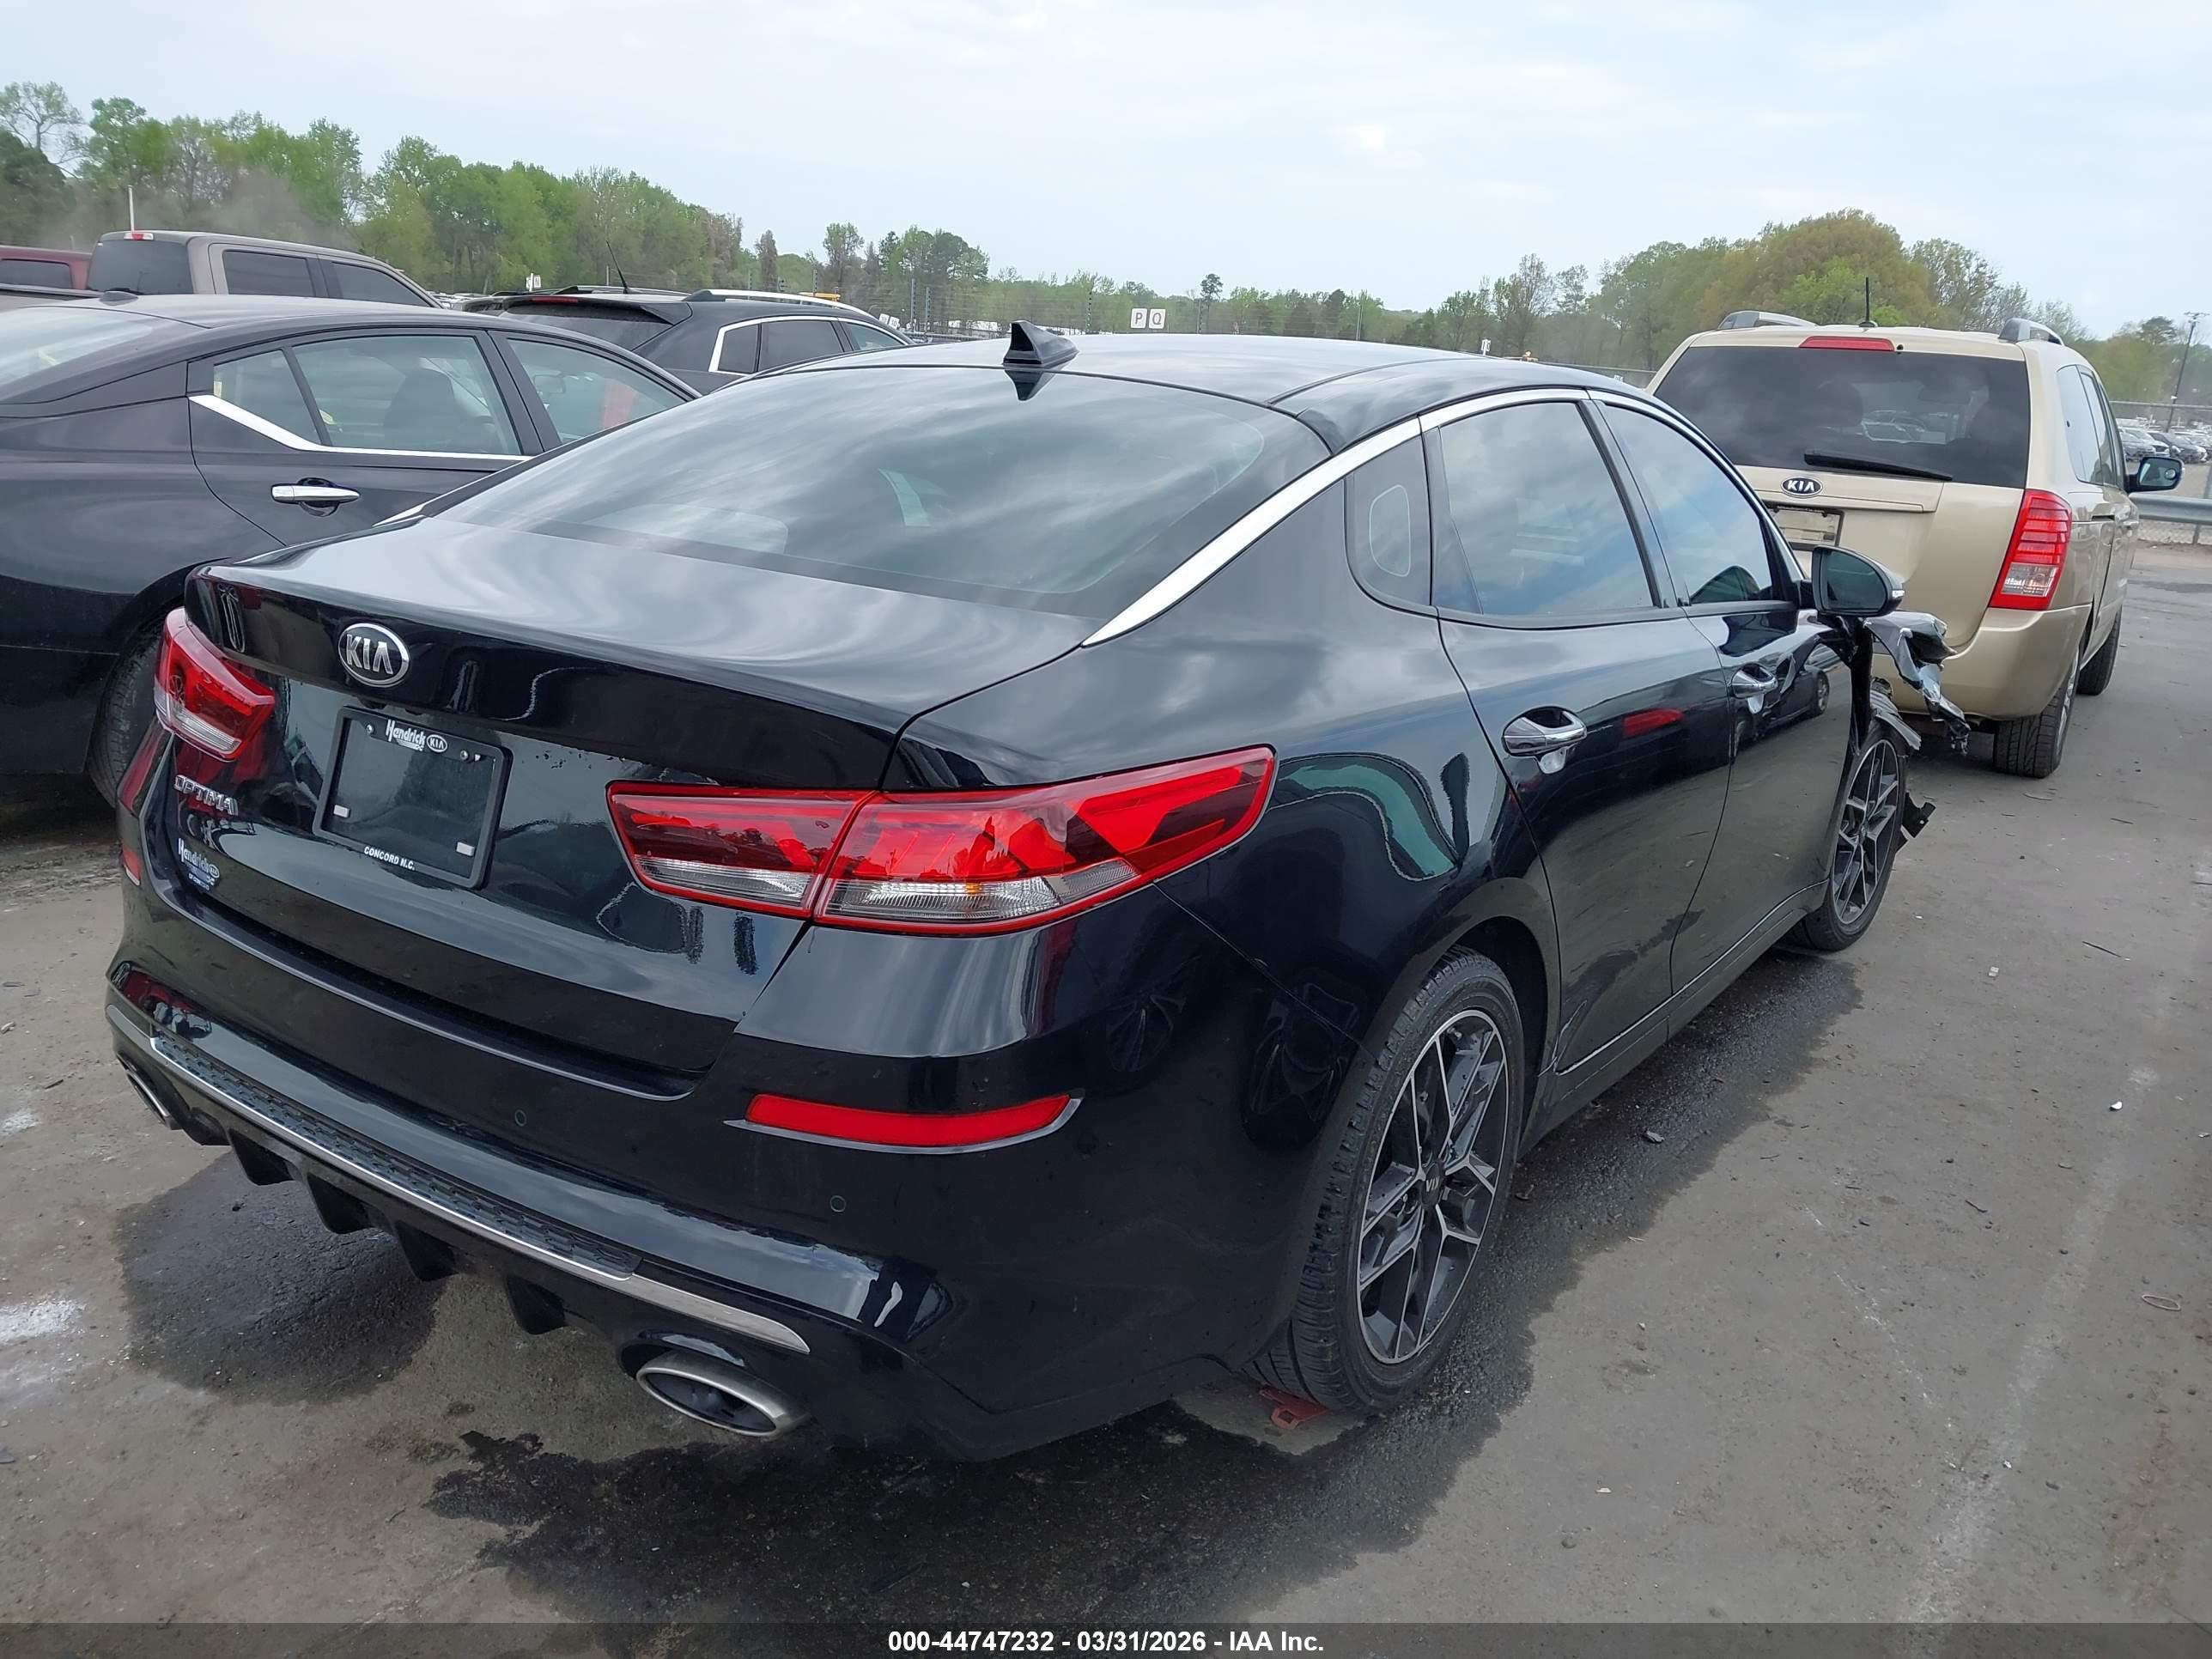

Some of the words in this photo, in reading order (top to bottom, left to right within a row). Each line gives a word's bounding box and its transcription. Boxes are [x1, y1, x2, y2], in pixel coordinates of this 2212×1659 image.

[1135, 312, 1143, 325] P
[1152, 312, 1162, 325] Q
[1787, 480, 1814, 492] KIA
[345, 634, 394, 676] KIA
[385, 719, 427, 745] Hendrick
[429, 737, 445, 750] KIA
[363, 846, 399, 866] CONCORD
[401, 858, 416, 871] N.C.
